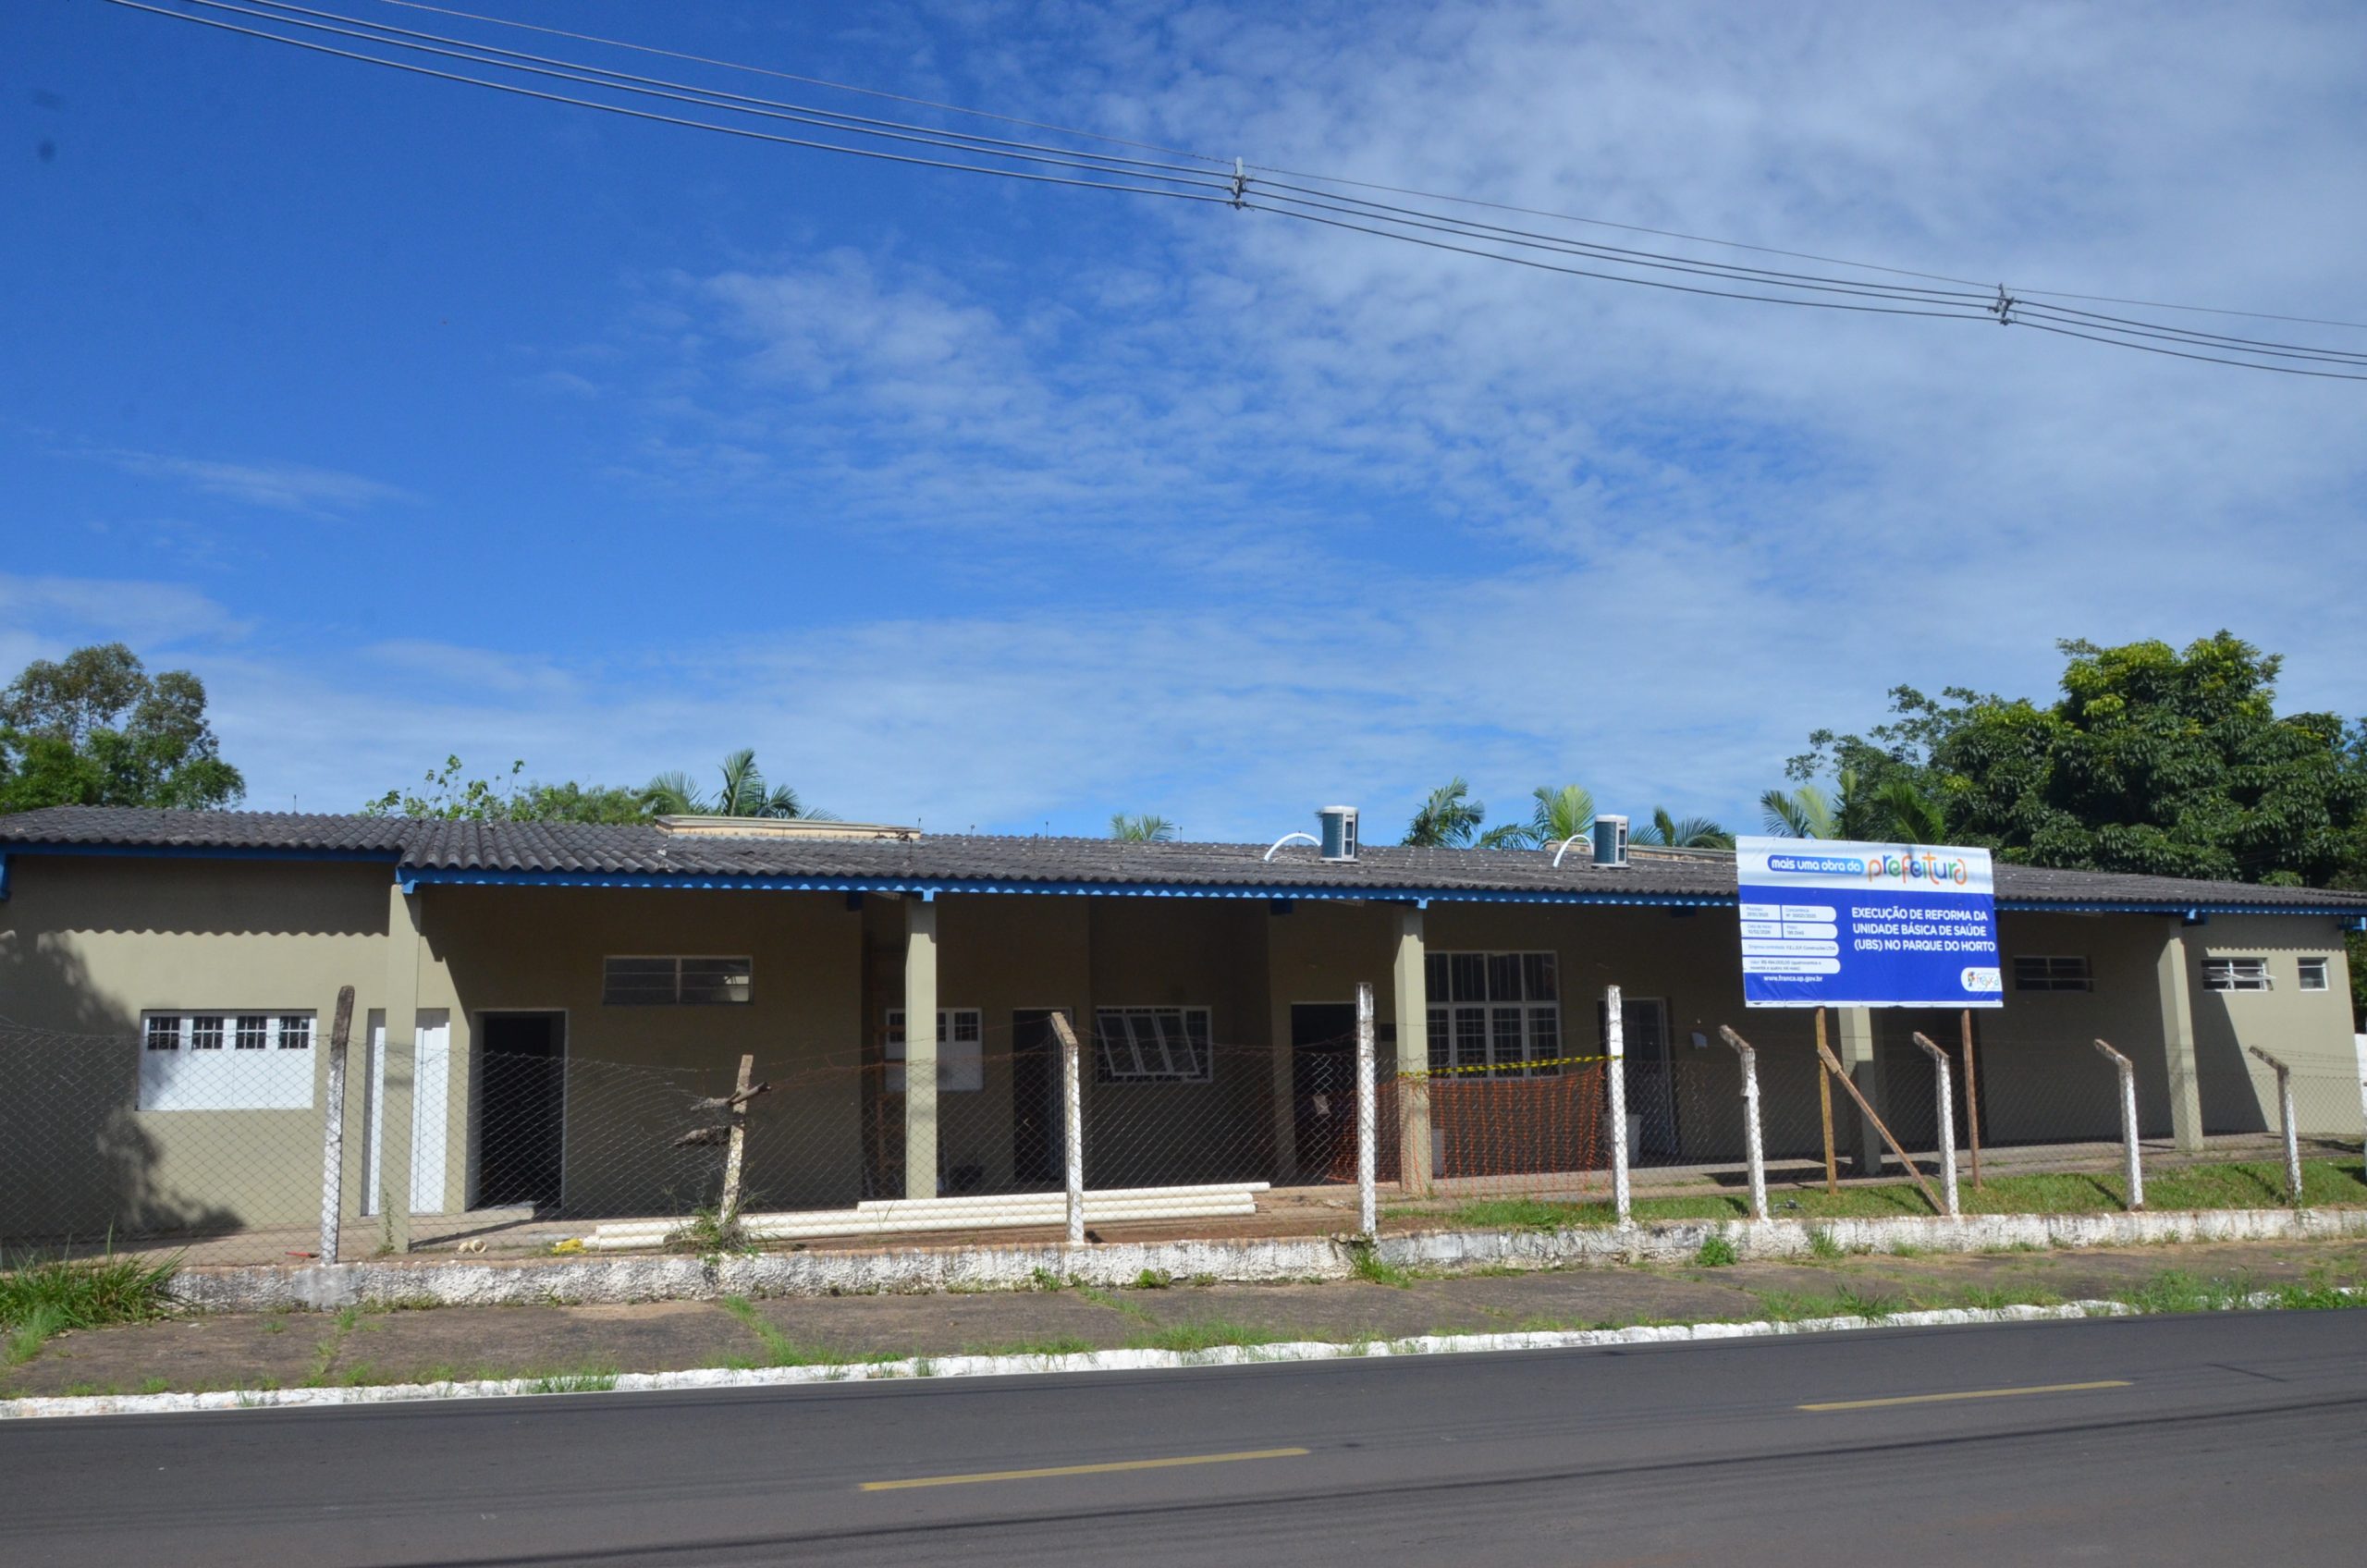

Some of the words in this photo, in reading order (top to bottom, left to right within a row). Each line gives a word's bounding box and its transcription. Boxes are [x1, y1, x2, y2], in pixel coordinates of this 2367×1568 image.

[1772, 858, 1795, 870] mais
[1797, 860, 1820, 871] uma
[1821, 859, 1846, 872] obra
[1846, 860, 1861, 873] da
[1868, 851, 1968, 886] prefeitura
[1851, 906, 1907, 921] EXECUÇÃO
[1909, 909, 1923, 920] DE
[1925, 909, 1972, 921] REFORMA
[1973, 911, 1988, 922] DA
[1852, 923, 1899, 935] UNIDADE
[1901, 922, 1937, 936] BÁSICA
[1939, 925, 1952, 936] DE
[1954, 923, 1987, 937] SAÚDE
[1854, 938, 1883, 951] (UBS)
[1884, 939, 1901, 950] NO
[1903, 940, 1943, 951] PARQUE
[1944, 940, 1959, 951] DO
[1961, 941, 1995, 952] HORTO
